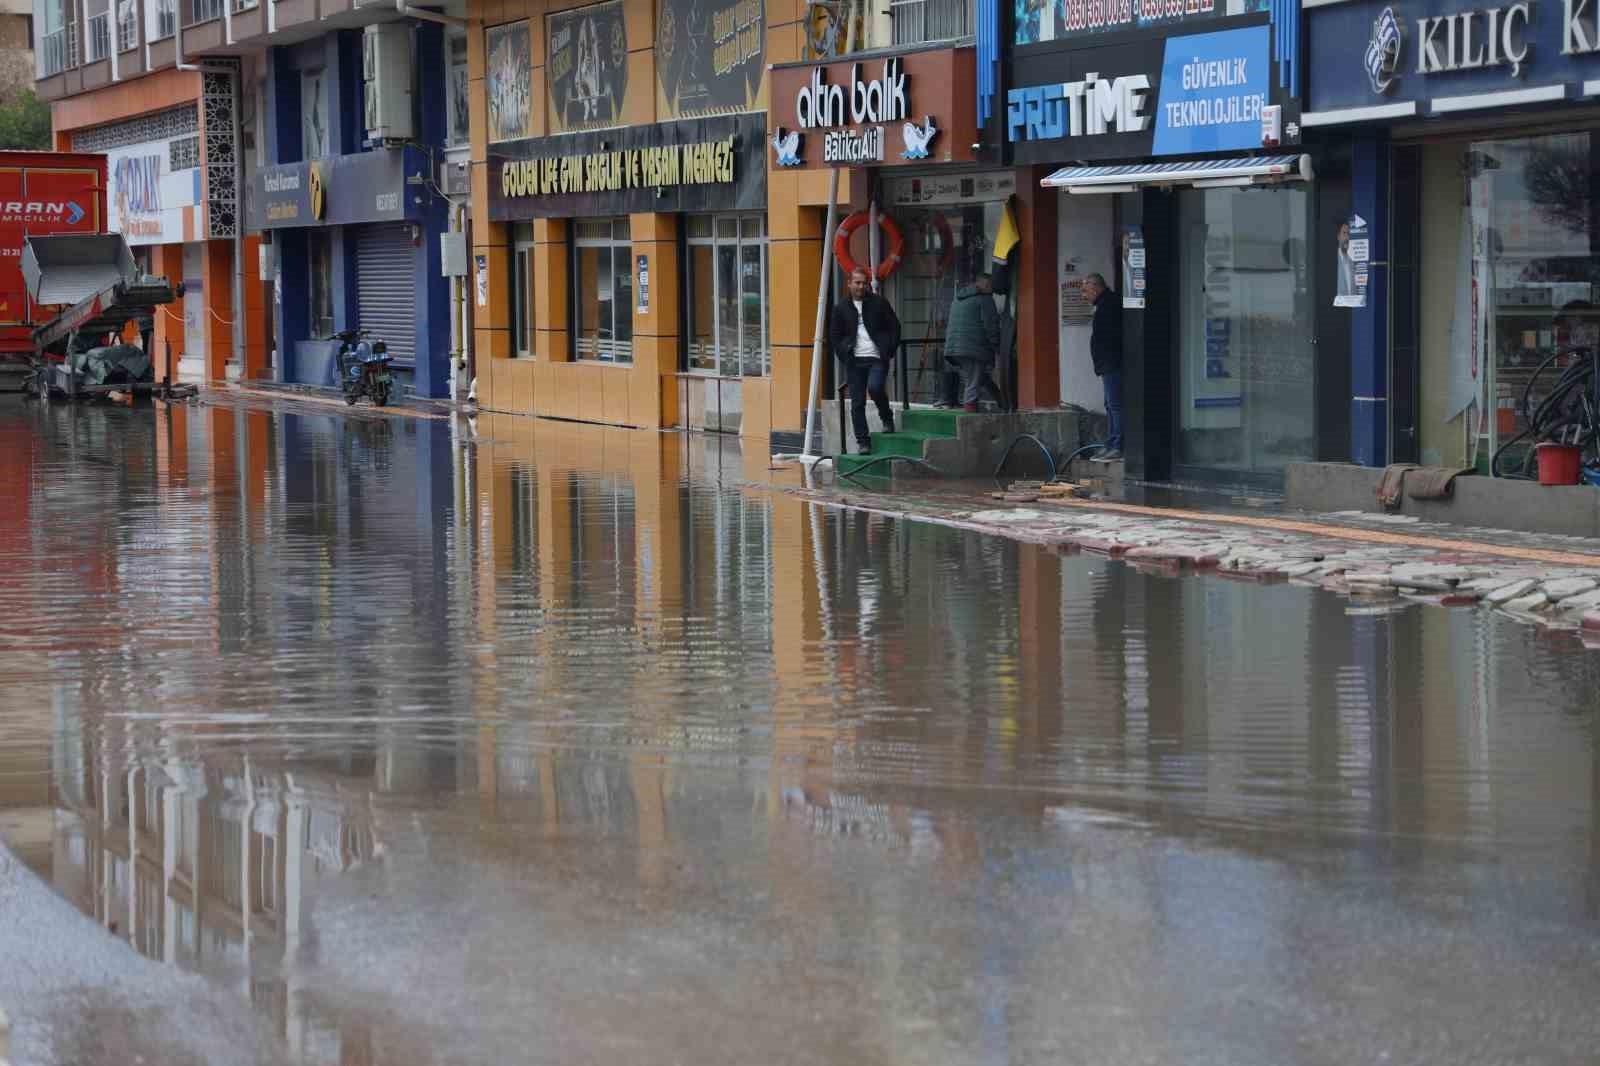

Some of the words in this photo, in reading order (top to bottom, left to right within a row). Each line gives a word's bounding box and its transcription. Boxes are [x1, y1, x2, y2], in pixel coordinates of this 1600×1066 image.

[1415, 4, 1529, 77] KILIÇ
[1560, 0, 1600, 55] K
[1183, 56, 1247, 90] GÜVENLİK
[1166, 93, 1265, 128] TEKNOLOJİLERİ
[502, 160, 538, 198] GOLDEN
[540, 157, 558, 195] LIFE
[560, 155, 583, 193] GYM
[586, 141, 621, 192] SAĞLIK
[624, 149, 640, 188] VE
[642, 145, 679, 198] YAŞAM
[683, 134, 734, 185] MERKEZİ
